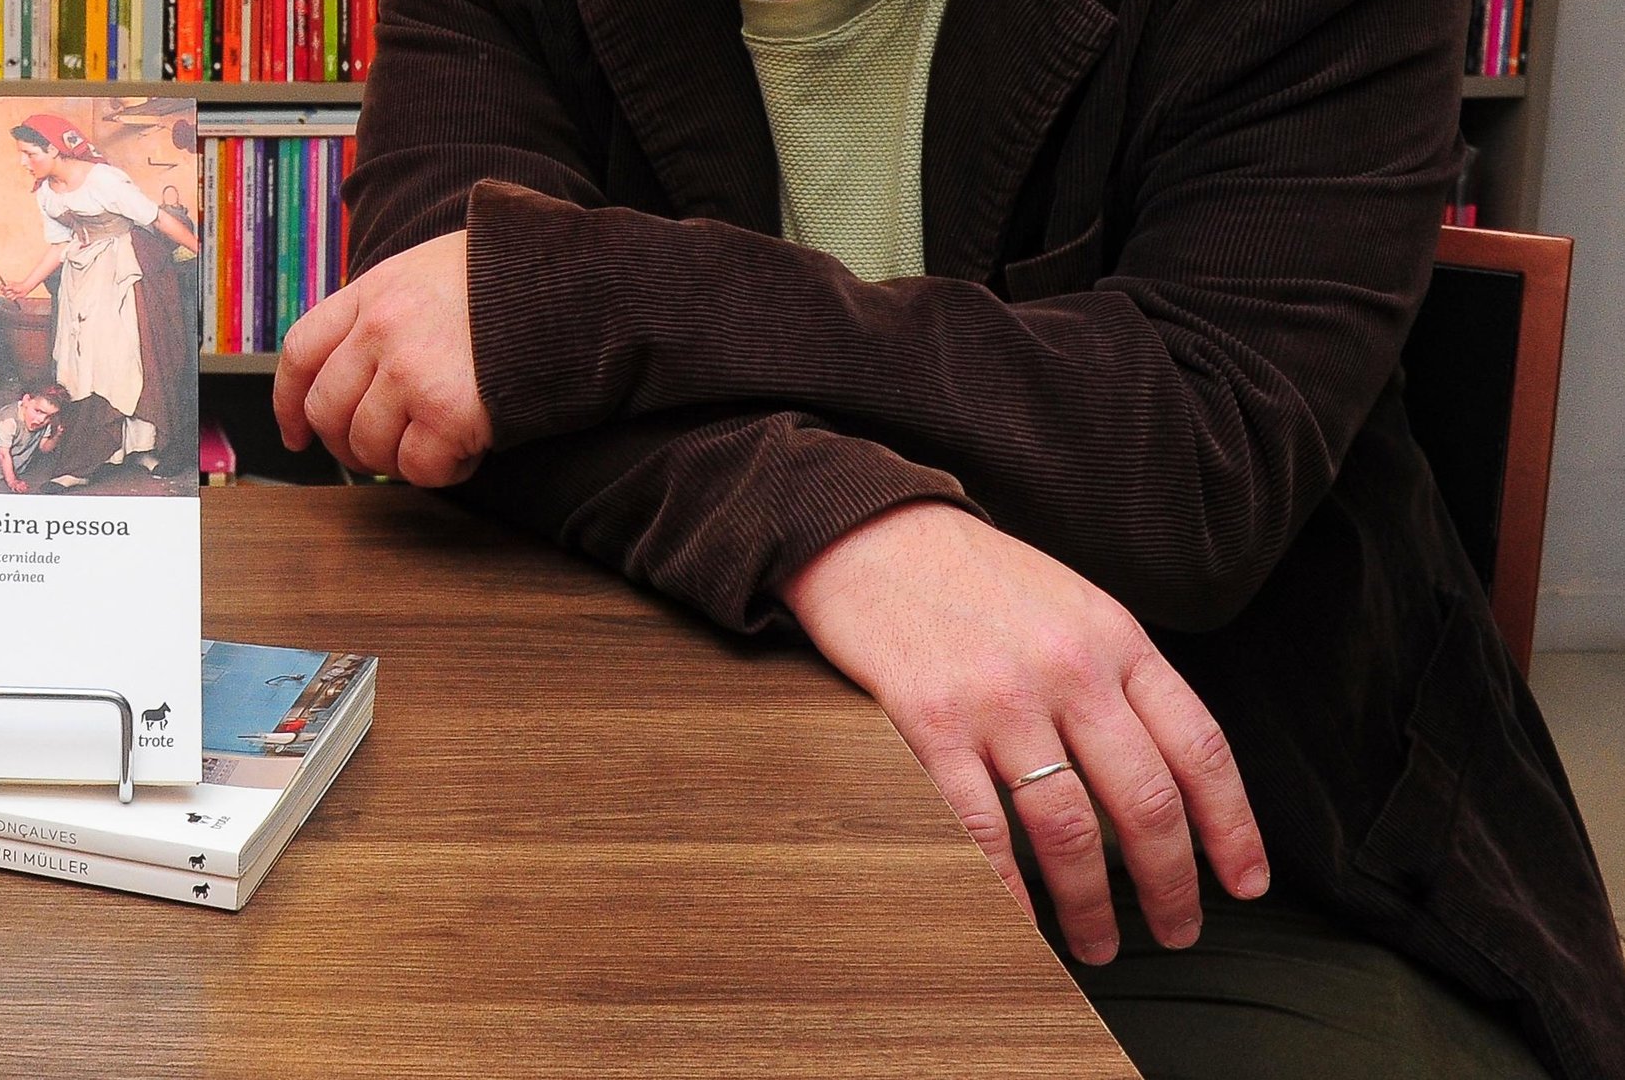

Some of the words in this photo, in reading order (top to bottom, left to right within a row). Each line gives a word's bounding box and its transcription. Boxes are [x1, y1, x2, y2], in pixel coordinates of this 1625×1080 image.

[45, 518, 131, 540] pessoa
[138, 733, 175, 749] trote
[23, 847, 90, 877] MÜLLER
